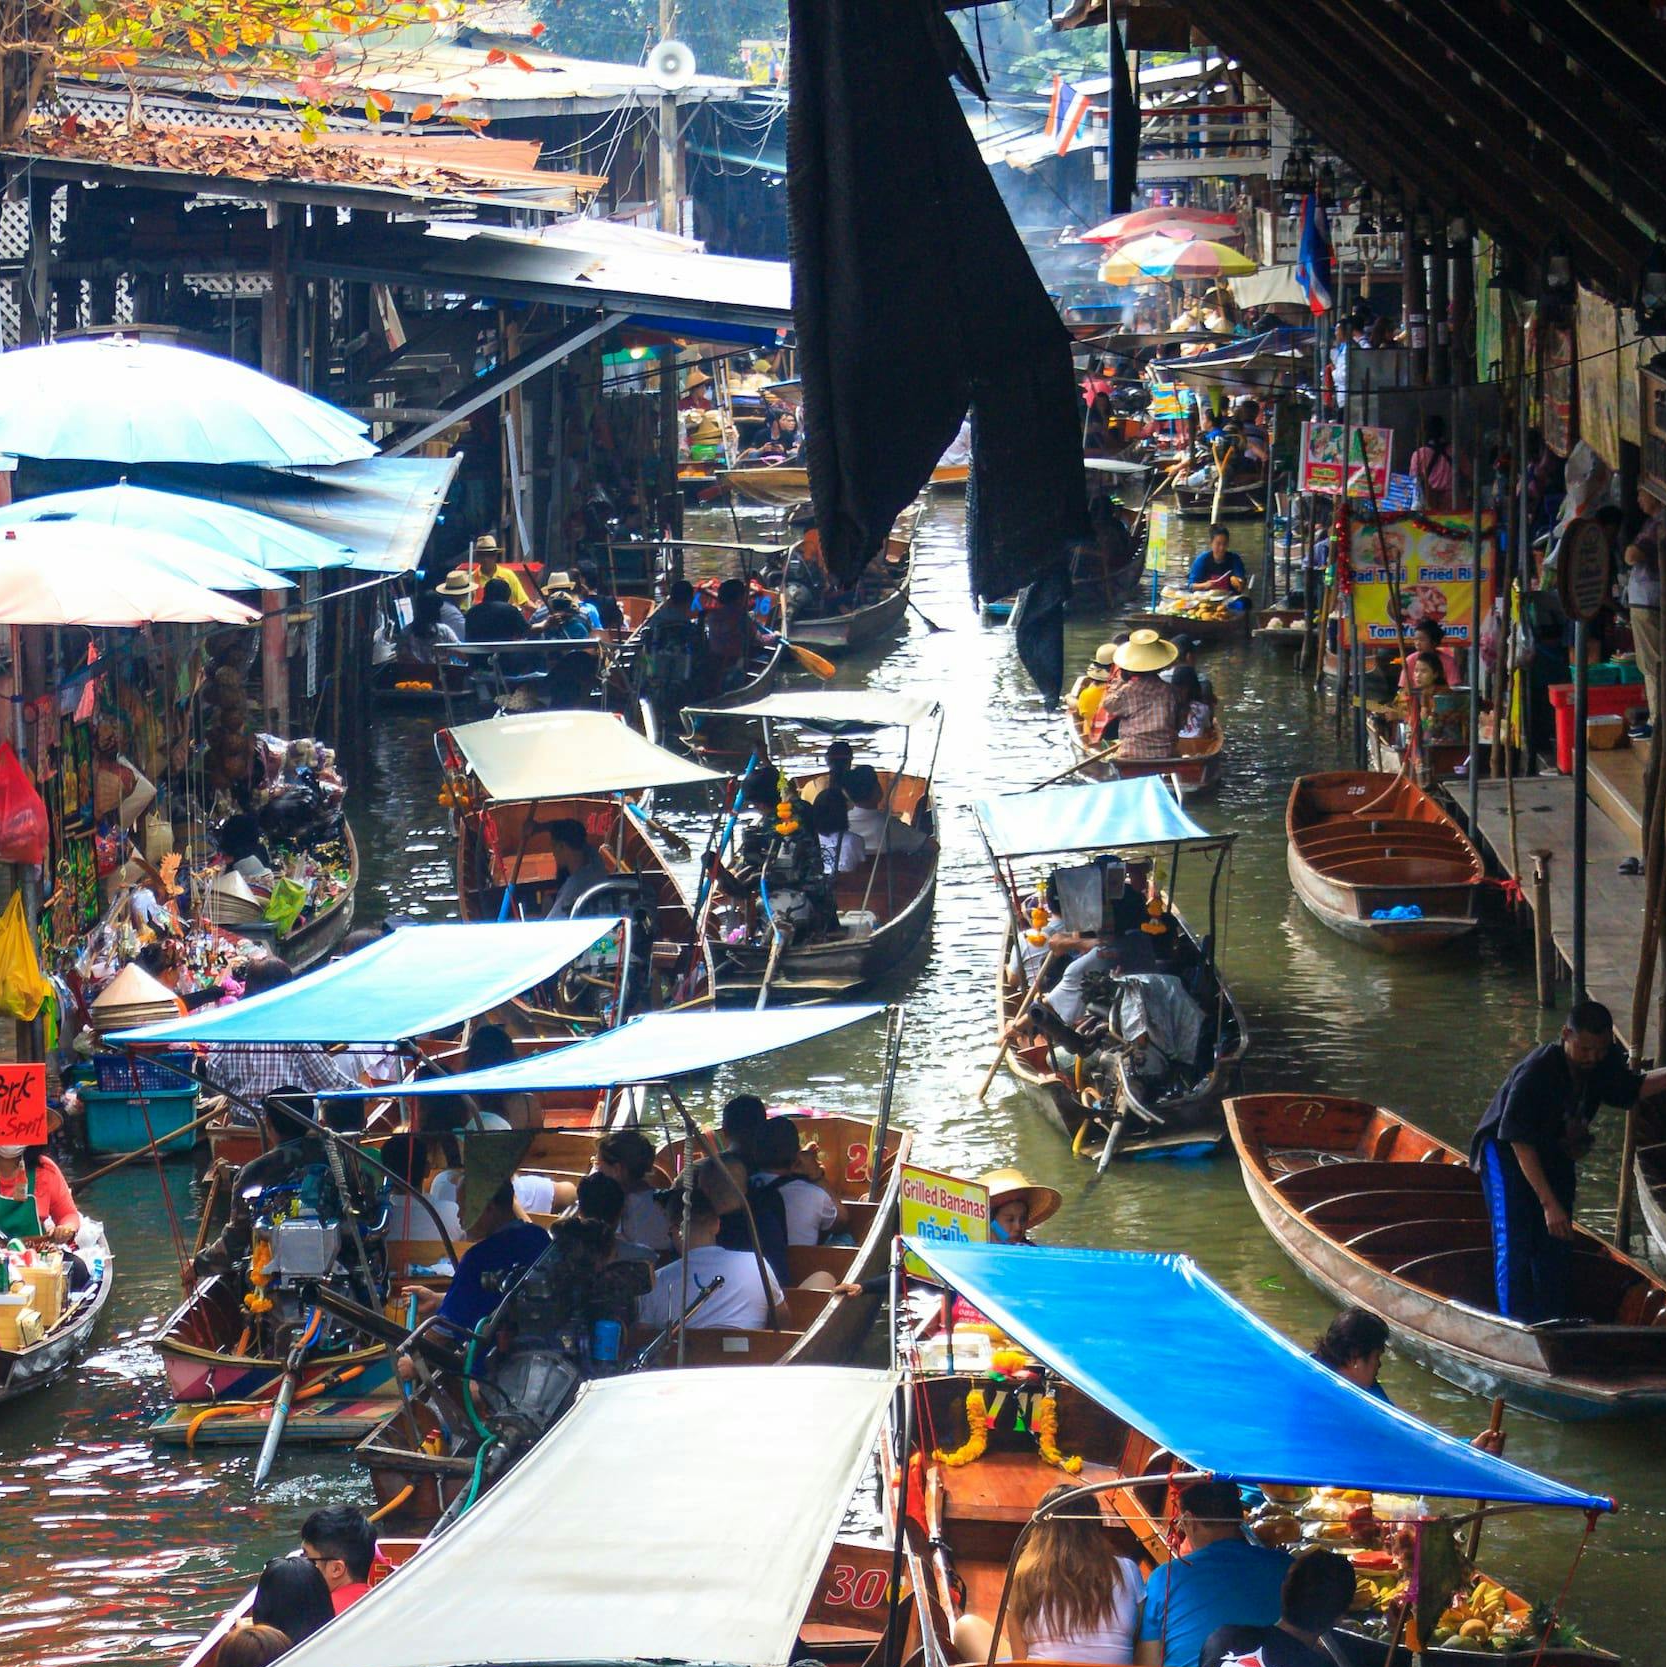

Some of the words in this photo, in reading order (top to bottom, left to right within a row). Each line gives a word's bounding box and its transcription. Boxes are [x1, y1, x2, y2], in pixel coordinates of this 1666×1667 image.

[1420, 568, 1454, 581] Fried
[1458, 567, 1488, 580] Rie
[1369, 624, 1397, 639] Tom
[1440, 624, 1468, 639] ung
[903, 1179, 939, 1206] Grilled
[940, 1189, 986, 1220] Bananas
[824, 1564, 890, 1610] 30
